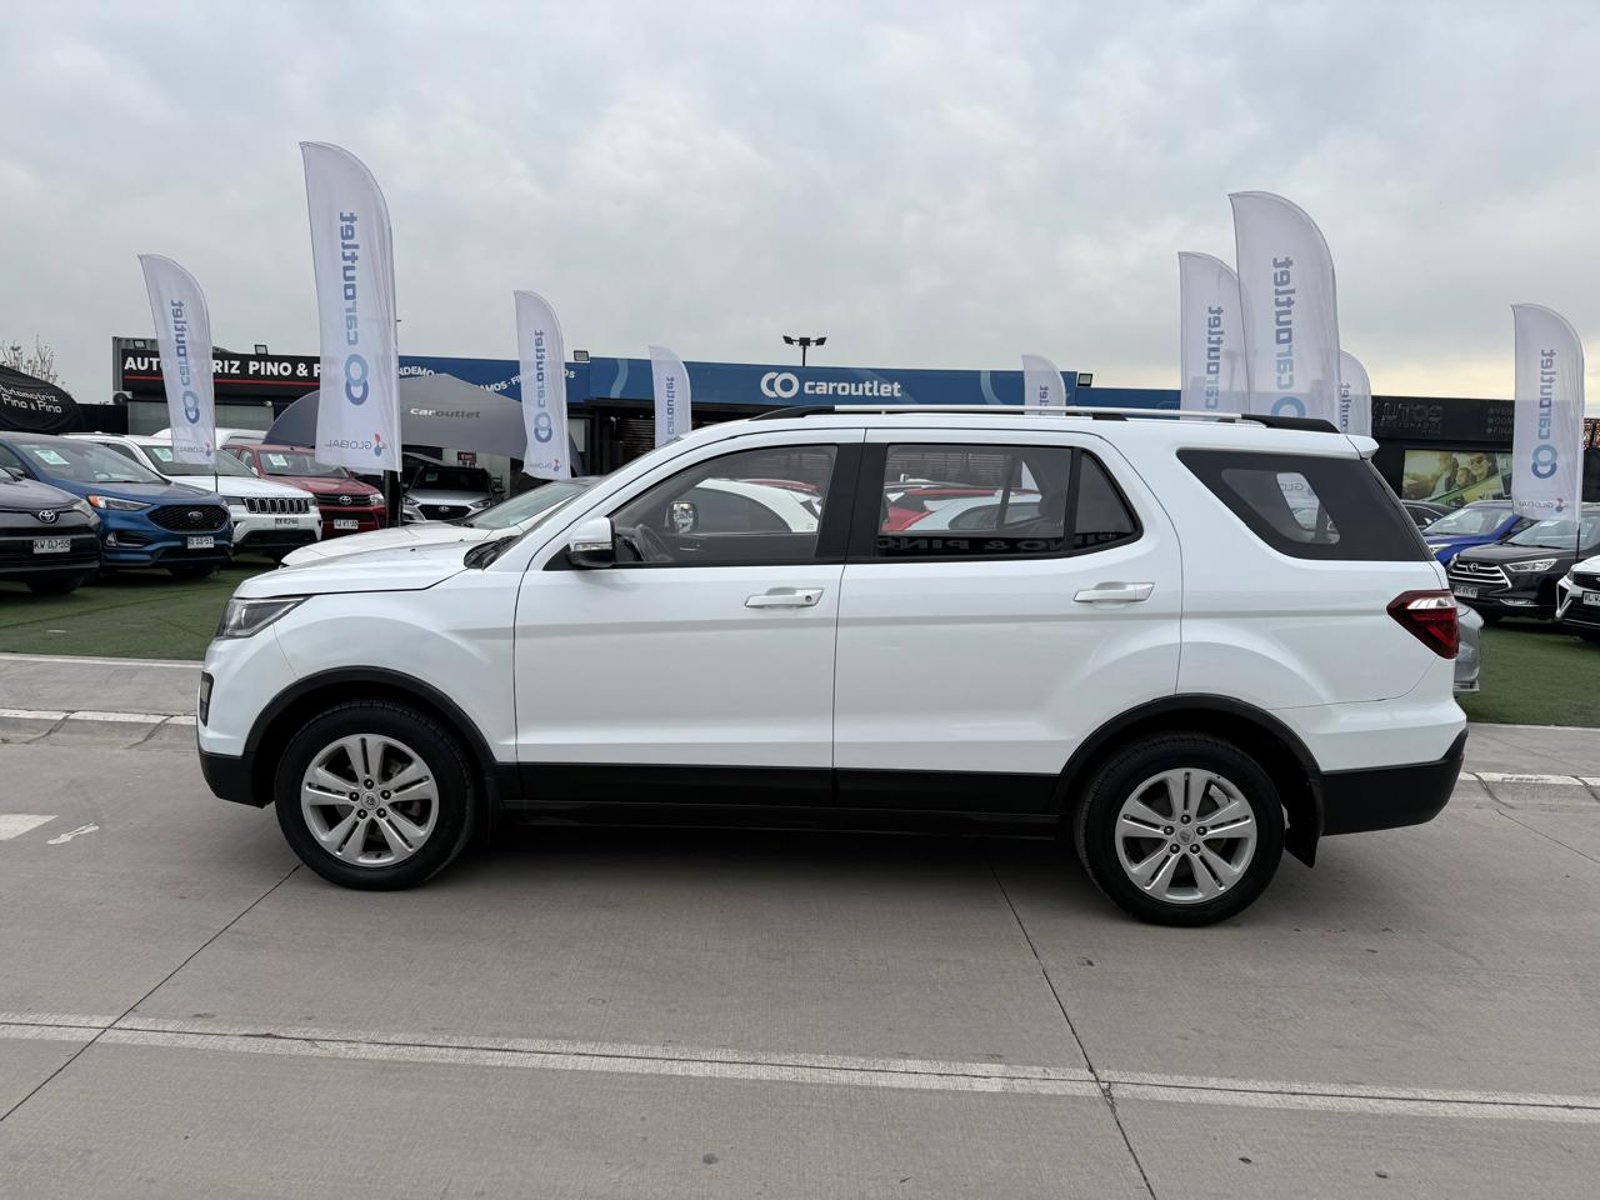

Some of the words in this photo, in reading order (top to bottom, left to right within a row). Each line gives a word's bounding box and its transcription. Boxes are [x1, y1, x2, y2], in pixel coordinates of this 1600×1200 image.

[124, 356, 240, 374] AUTRIZ
[249, 361, 292, 376] PINO
[296, 363, 308, 377] &
[804, 379, 902, 398] caroutlet
[36, 399, 62, 413] Pino
[410, 407, 481, 419] caroutlet
